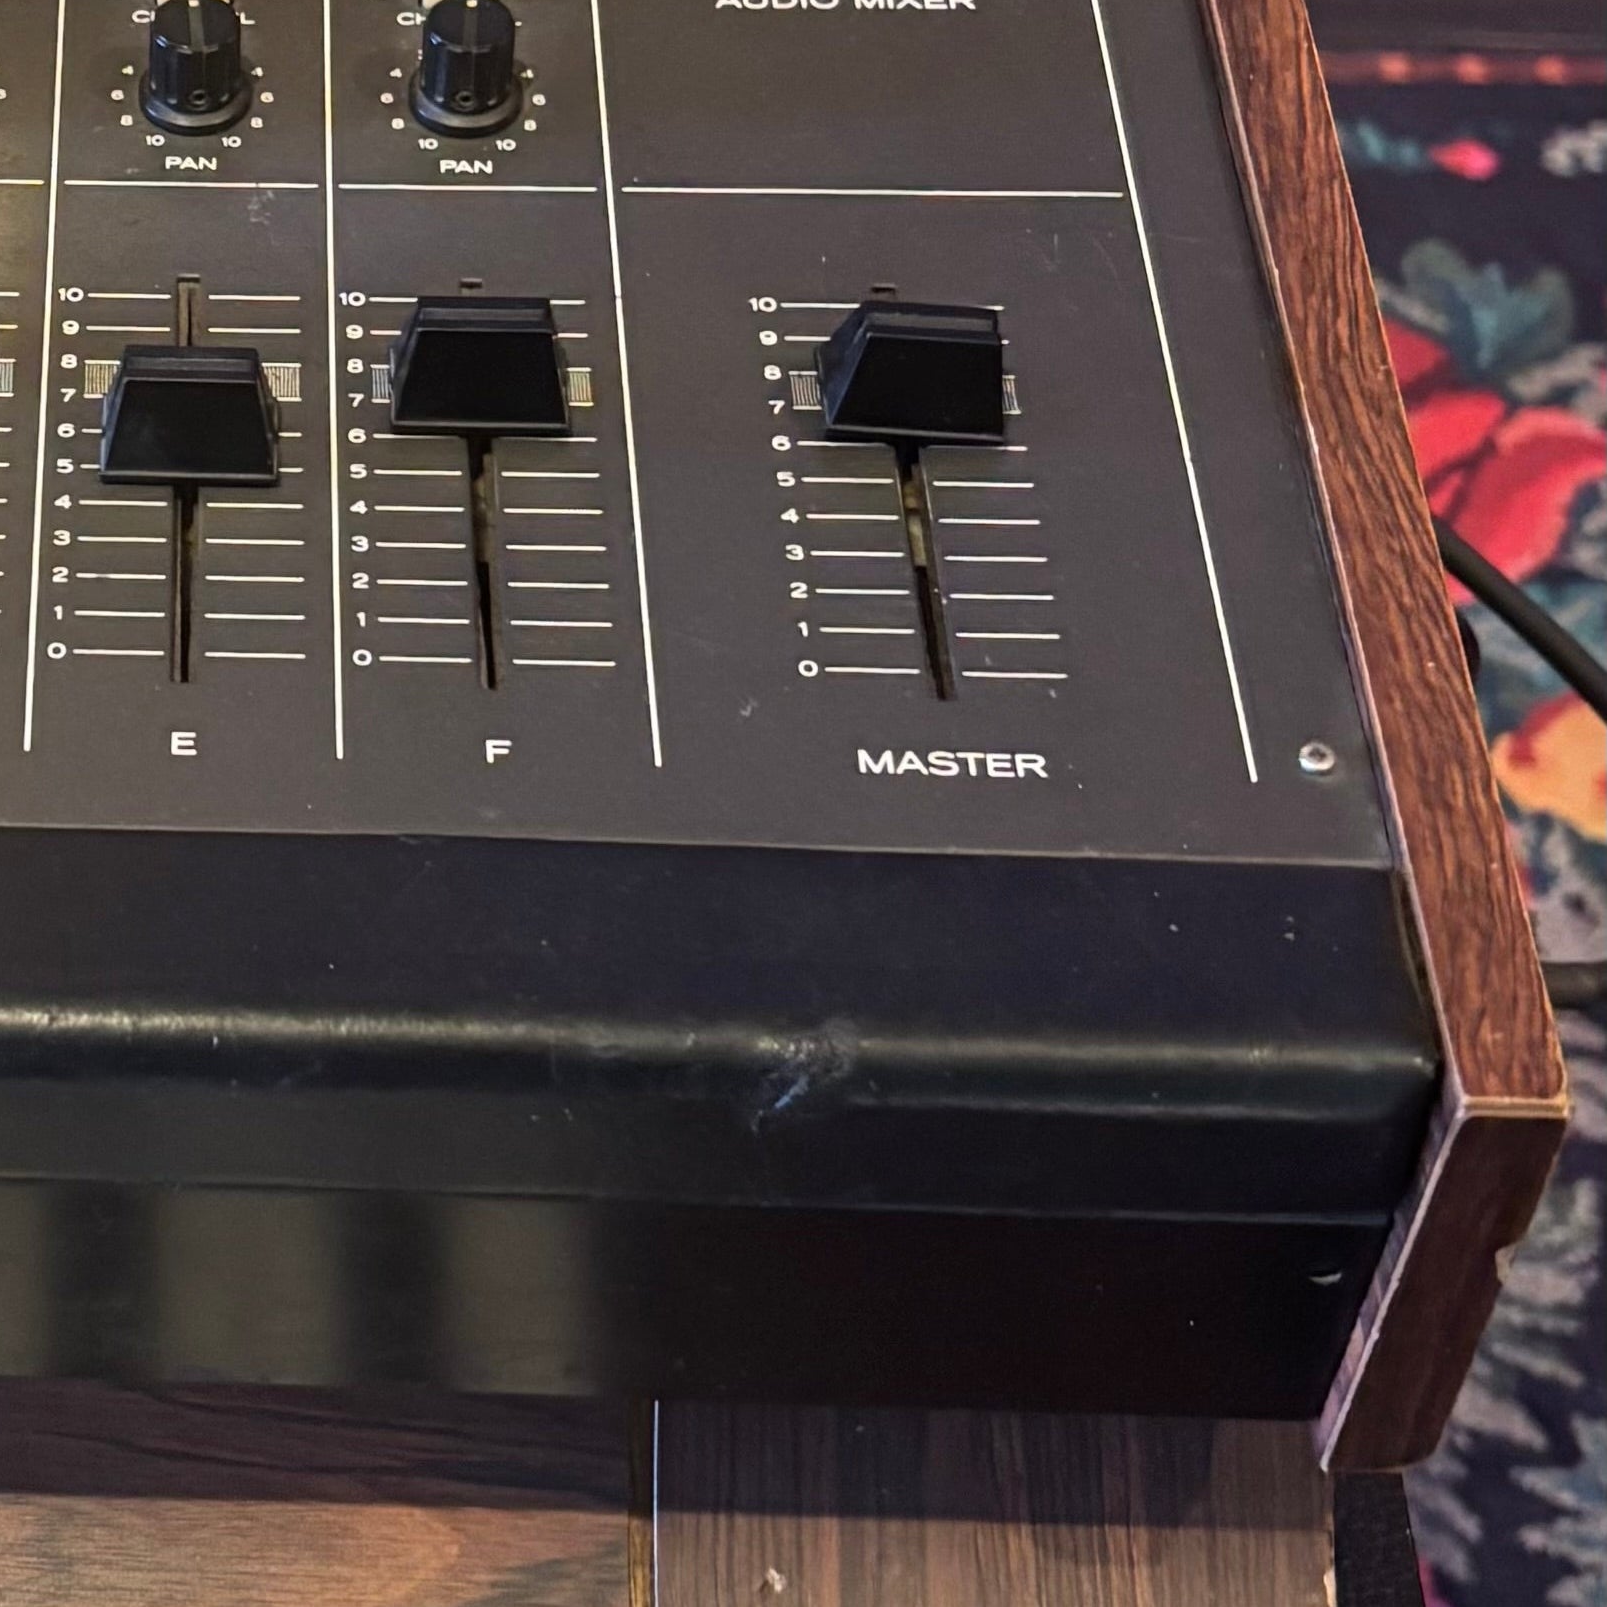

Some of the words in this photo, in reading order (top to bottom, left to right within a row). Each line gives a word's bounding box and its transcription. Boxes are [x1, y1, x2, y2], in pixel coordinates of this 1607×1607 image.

[164, 156, 218, 171] PAN
[439, 160, 494, 174] PAN
[747, 298, 778, 313] 10
[758, 331, 779, 345] 9
[763, 366, 783, 380] 8
[768, 400, 786, 413] 7
[771, 436, 792, 451] 6
[776, 472, 796, 486] 5
[780, 509, 800, 523] 4
[785, 545, 805, 560] 3
[790, 582, 808, 598] 2
[797, 622, 810, 636] 1
[798, 660, 820, 677] 0
[170, 732, 198, 755] E
[486, 739, 513, 763] F
[857, 749, 1048, 779] MASTER
